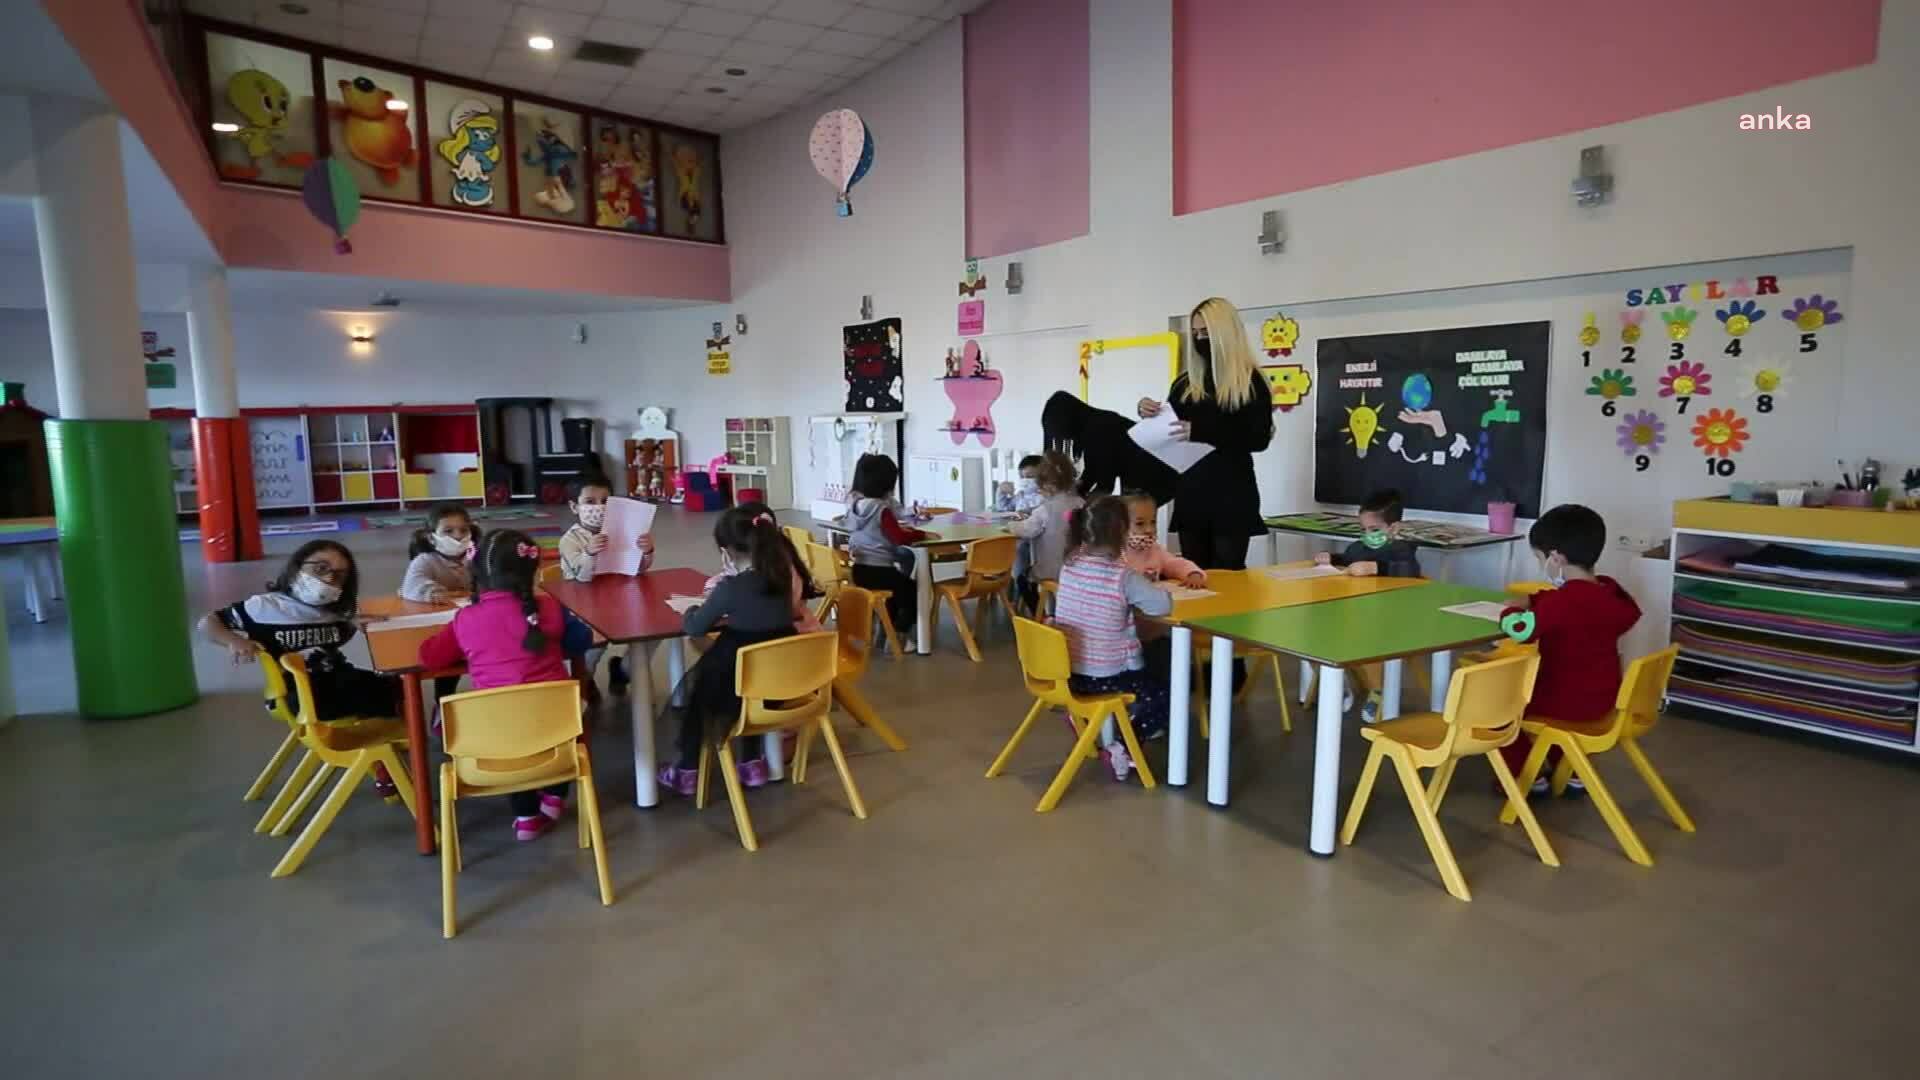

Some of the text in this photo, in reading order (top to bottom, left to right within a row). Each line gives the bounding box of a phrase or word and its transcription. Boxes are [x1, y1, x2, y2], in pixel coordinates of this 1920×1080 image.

[1627, 275, 1779, 306] SAYILAR
[1669, 342, 1685, 360] 3
[1724, 338, 1743, 357] 4
[1799, 333, 1818, 353] 5
[1582, 351, 1591, 368] 1
[1621, 346, 1636, 364] 2
[1601, 401, 1616, 417] 6
[1676, 396, 1691, 414] 7
[1756, 394, 1773, 413] 8
[1635, 454, 1650, 472] 9
[1706, 457, 1736, 477] 10
